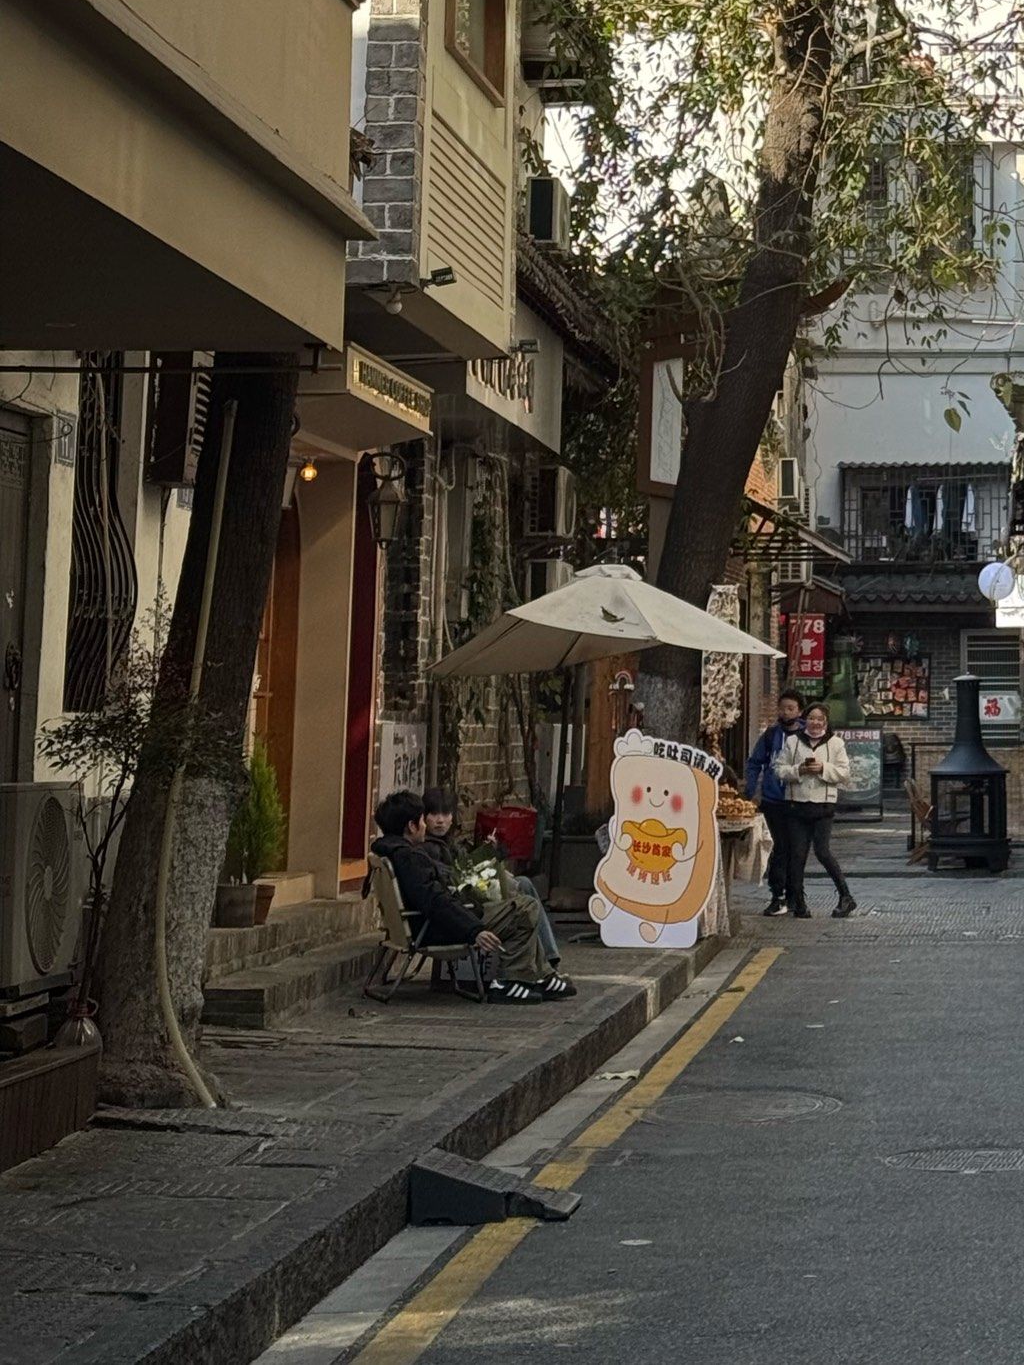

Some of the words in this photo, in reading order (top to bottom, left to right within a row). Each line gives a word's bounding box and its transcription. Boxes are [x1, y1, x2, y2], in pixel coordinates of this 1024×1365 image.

[984, 697, 1002, 718] 福
[653, 742, 721, 780] 吃吐司请进
